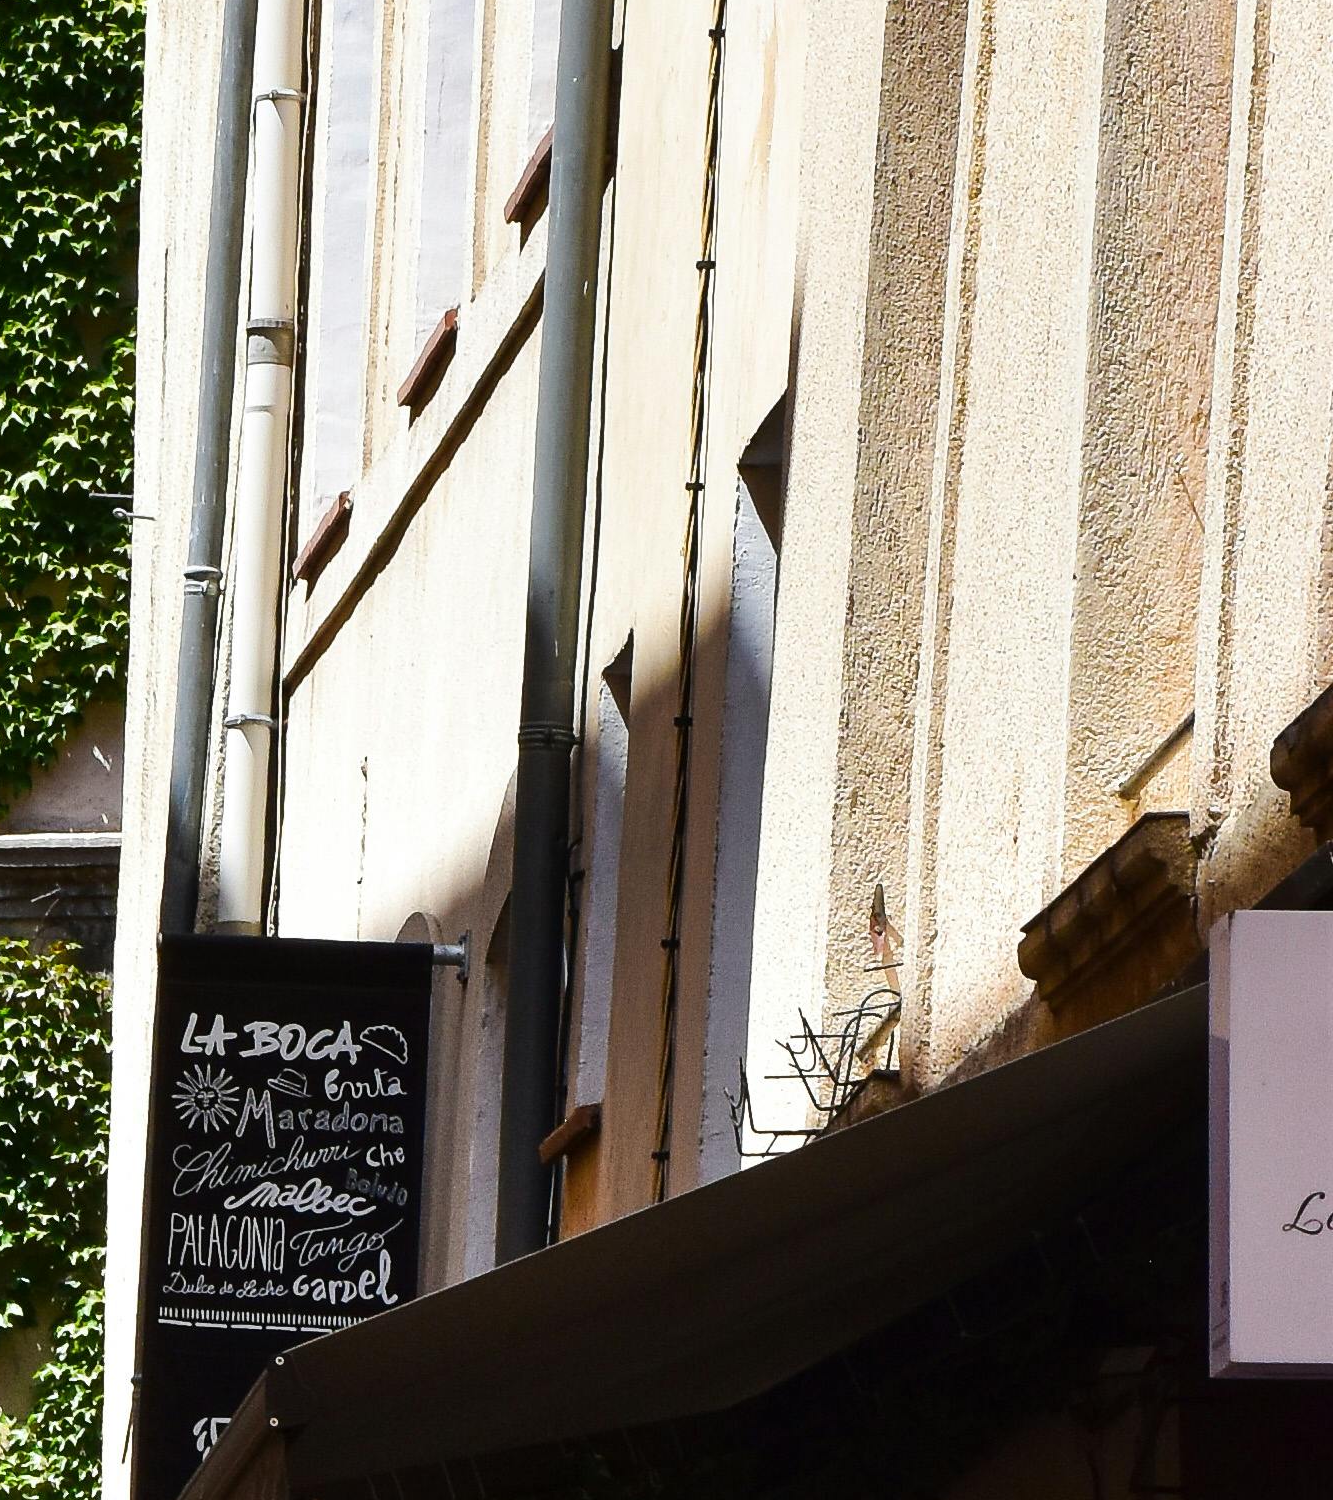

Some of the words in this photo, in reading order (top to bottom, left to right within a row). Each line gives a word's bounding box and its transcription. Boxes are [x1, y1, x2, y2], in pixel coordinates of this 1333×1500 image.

[181, 1012, 237, 1056] LA
[239, 1020, 362, 1065] BOCA
[235, 1088, 404, 1148] Maradona
[172, 1135, 362, 1197] Chimichurri
[289, 1217, 404, 1273] Tango
[162, 1271, 216, 1295] Dulce
[219, 1277, 234, 1296] de
[235, 1279, 288, 1298] Leche
